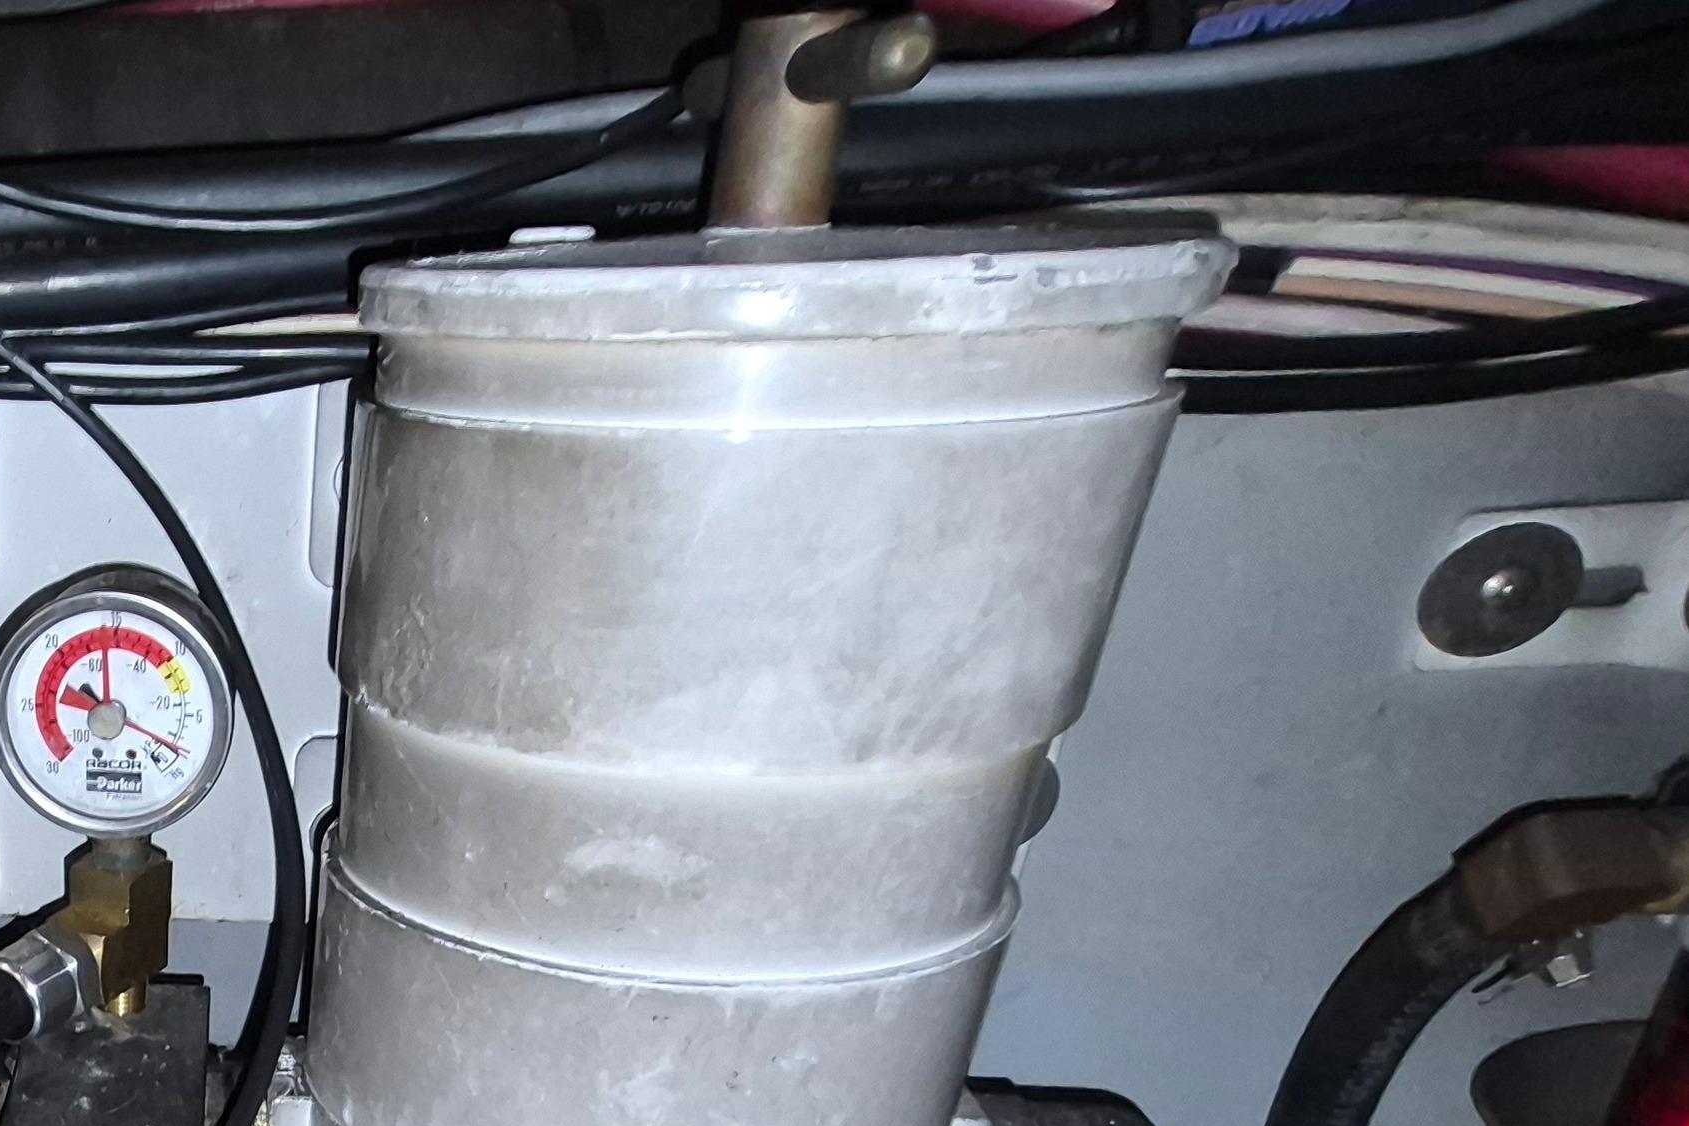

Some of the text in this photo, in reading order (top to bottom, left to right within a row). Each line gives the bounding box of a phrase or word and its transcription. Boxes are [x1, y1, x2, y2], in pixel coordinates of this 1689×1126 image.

[44, 633, 59, 648] 20
[175, 640, 186, 655] 10
[46, 761, 60, 775] 30
[96, 776, 142, 793] Parker
